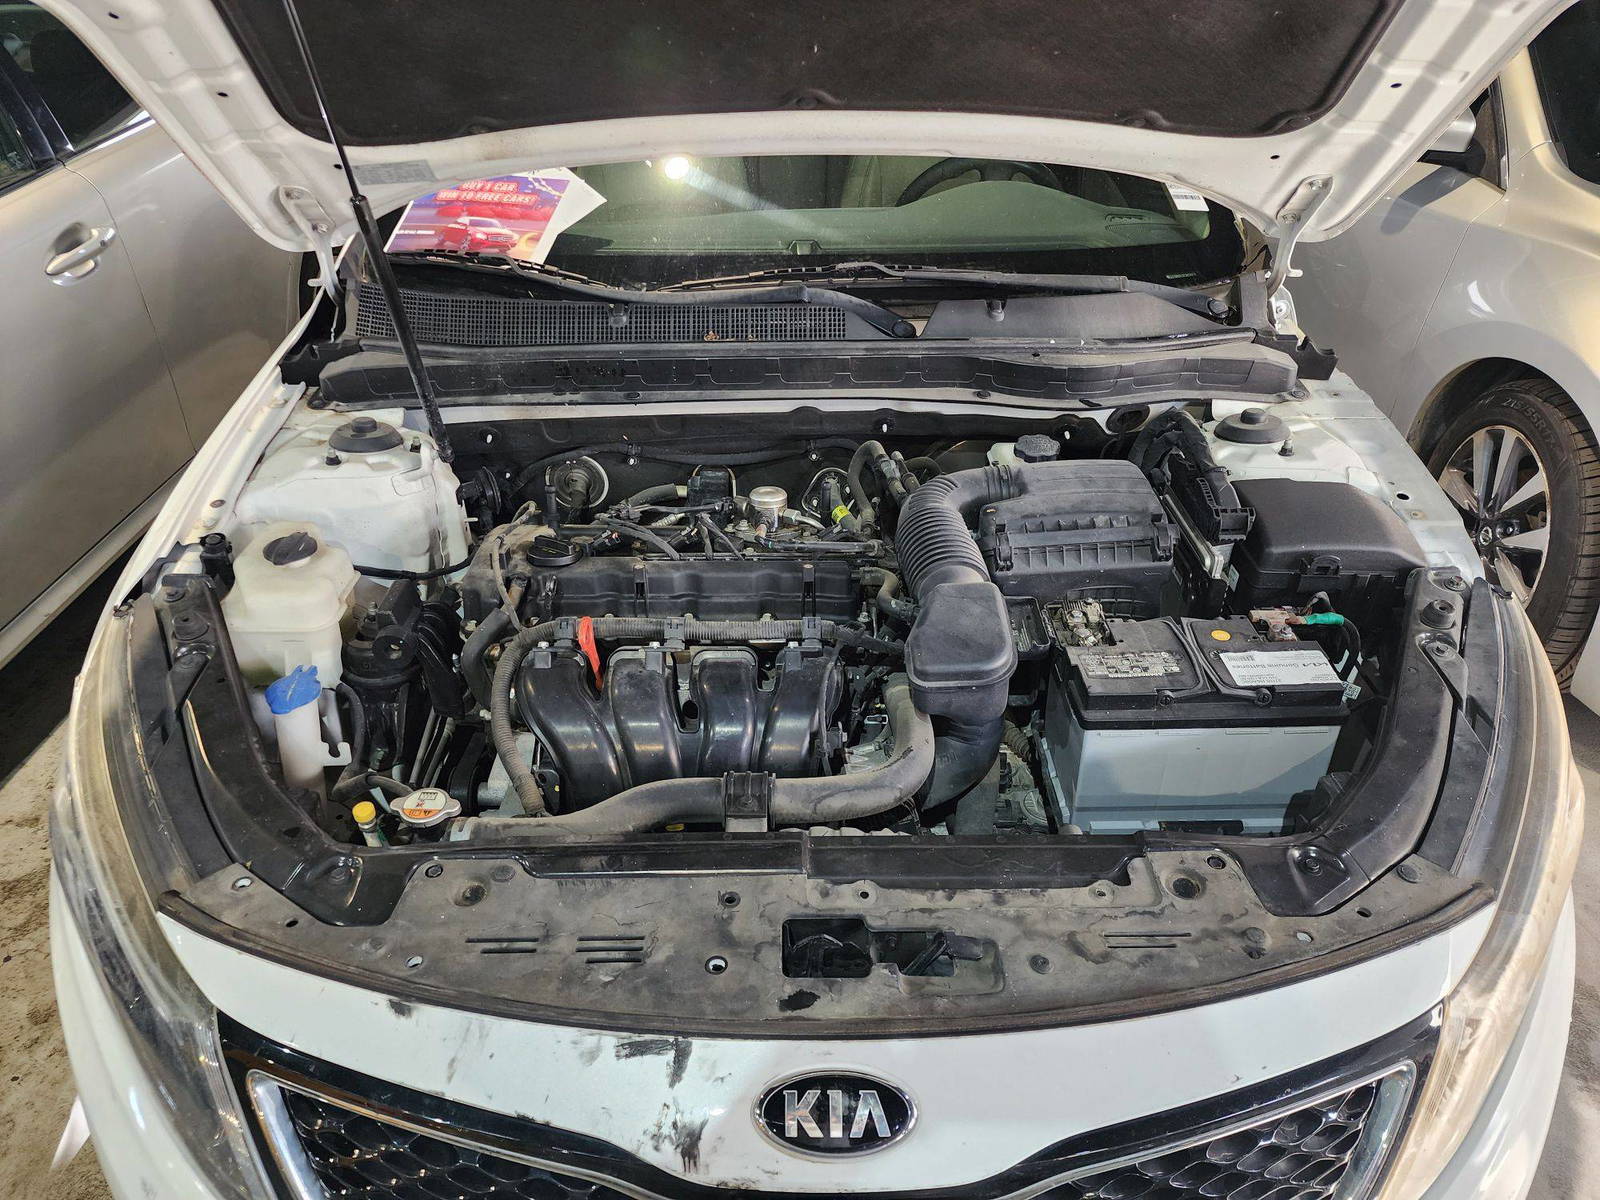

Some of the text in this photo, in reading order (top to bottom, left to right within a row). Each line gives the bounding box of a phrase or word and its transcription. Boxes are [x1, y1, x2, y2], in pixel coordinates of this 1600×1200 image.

[494, 182, 517, 191] CAR
[438, 191, 458, 200] WIN
[475, 192, 500, 201] FREE
[783, 1090, 892, 1138] KIA
